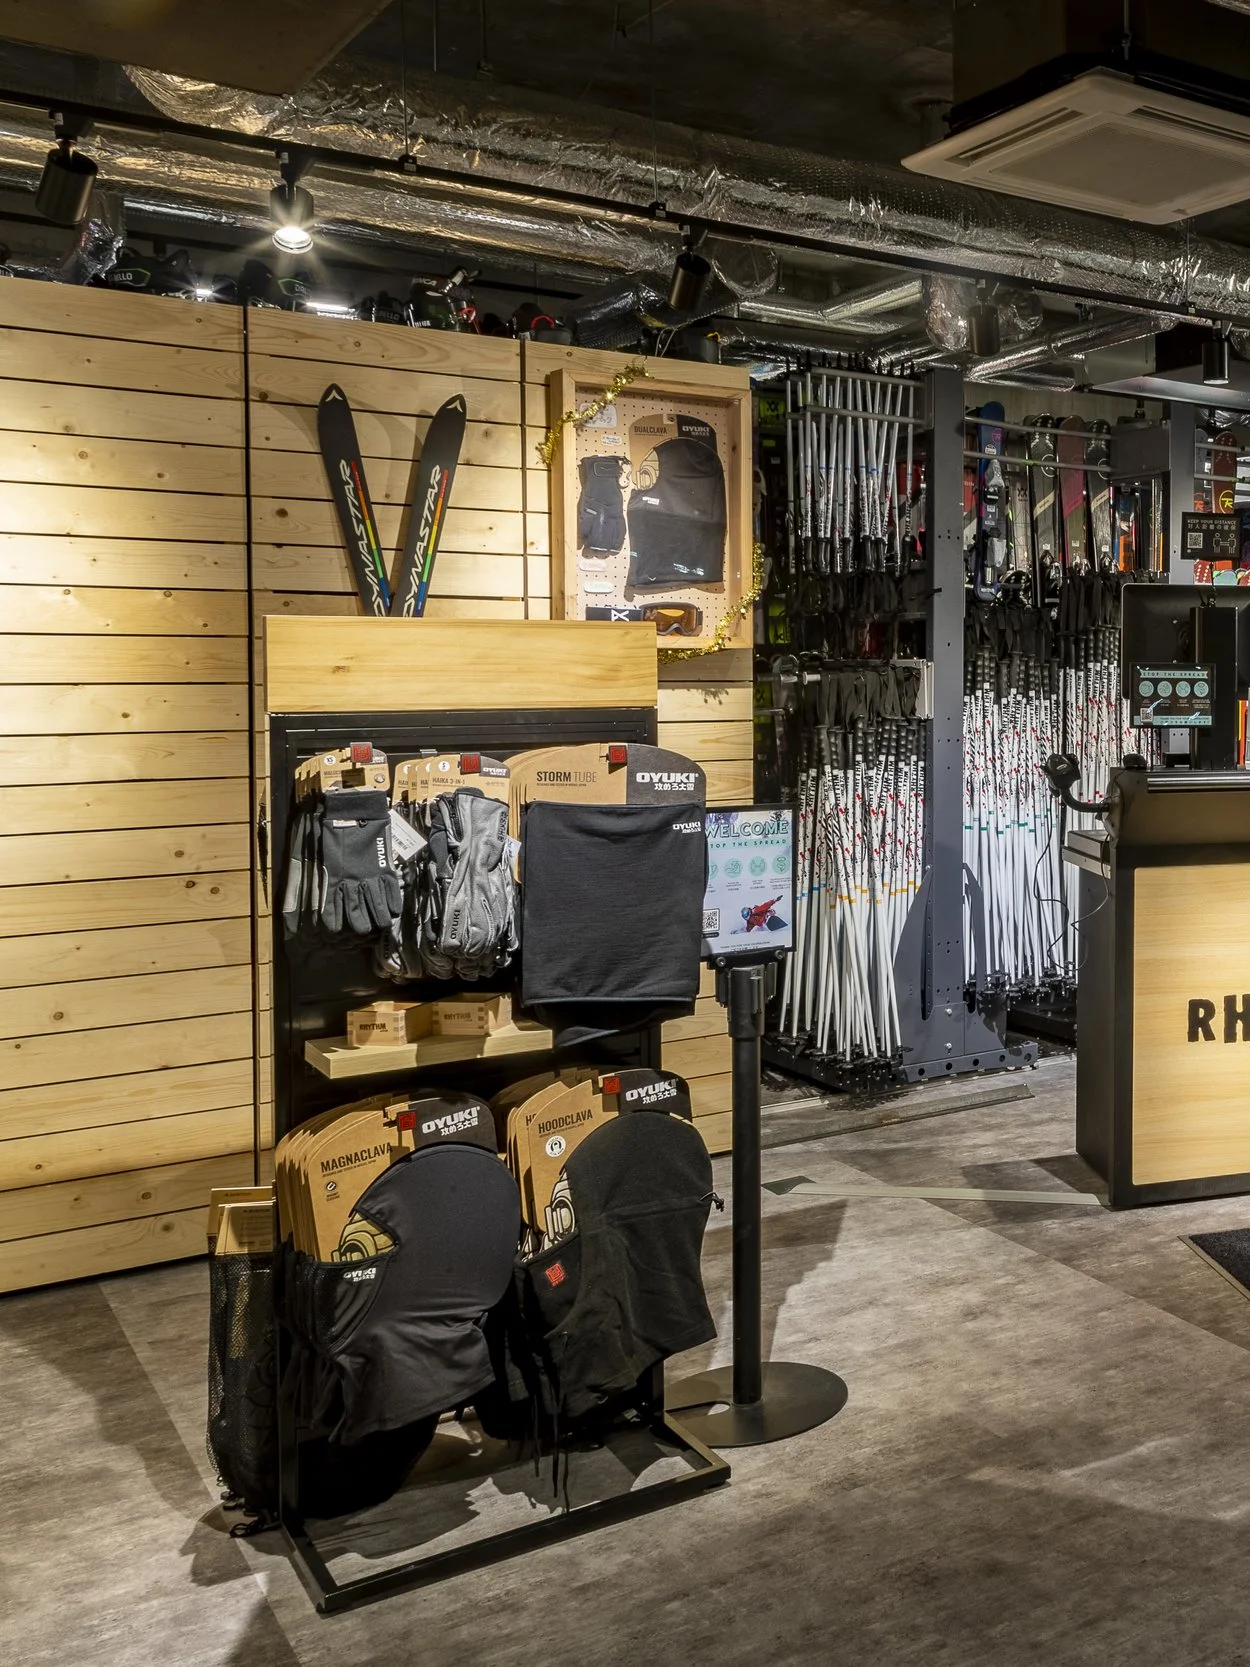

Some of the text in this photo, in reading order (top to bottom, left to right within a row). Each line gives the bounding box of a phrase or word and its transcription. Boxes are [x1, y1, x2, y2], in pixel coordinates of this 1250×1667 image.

[339, 459, 386, 617] DYNASTAR
[403, 465, 442, 617] DYNASTAR
[536, 771, 597, 783] STORM TUBE
[654, 782, 695, 791] 攻めろ大雪
[672, 821, 701, 831] OYUKI
[705, 820, 789, 838] WELCOME
[376, 837, 387, 867] OYUKI
[450, 909, 461, 939] OYUKI
[359, 1022, 387, 1031] RHYTHM
[642, 1089, 678, 1105] 攻めろ大雪
[441, 1117, 479, 1137] 攻めろ大雪
[538, 1109, 593, 1134] HOODCLAVA
[320, 1142, 393, 1174] MAGNACLAVA
